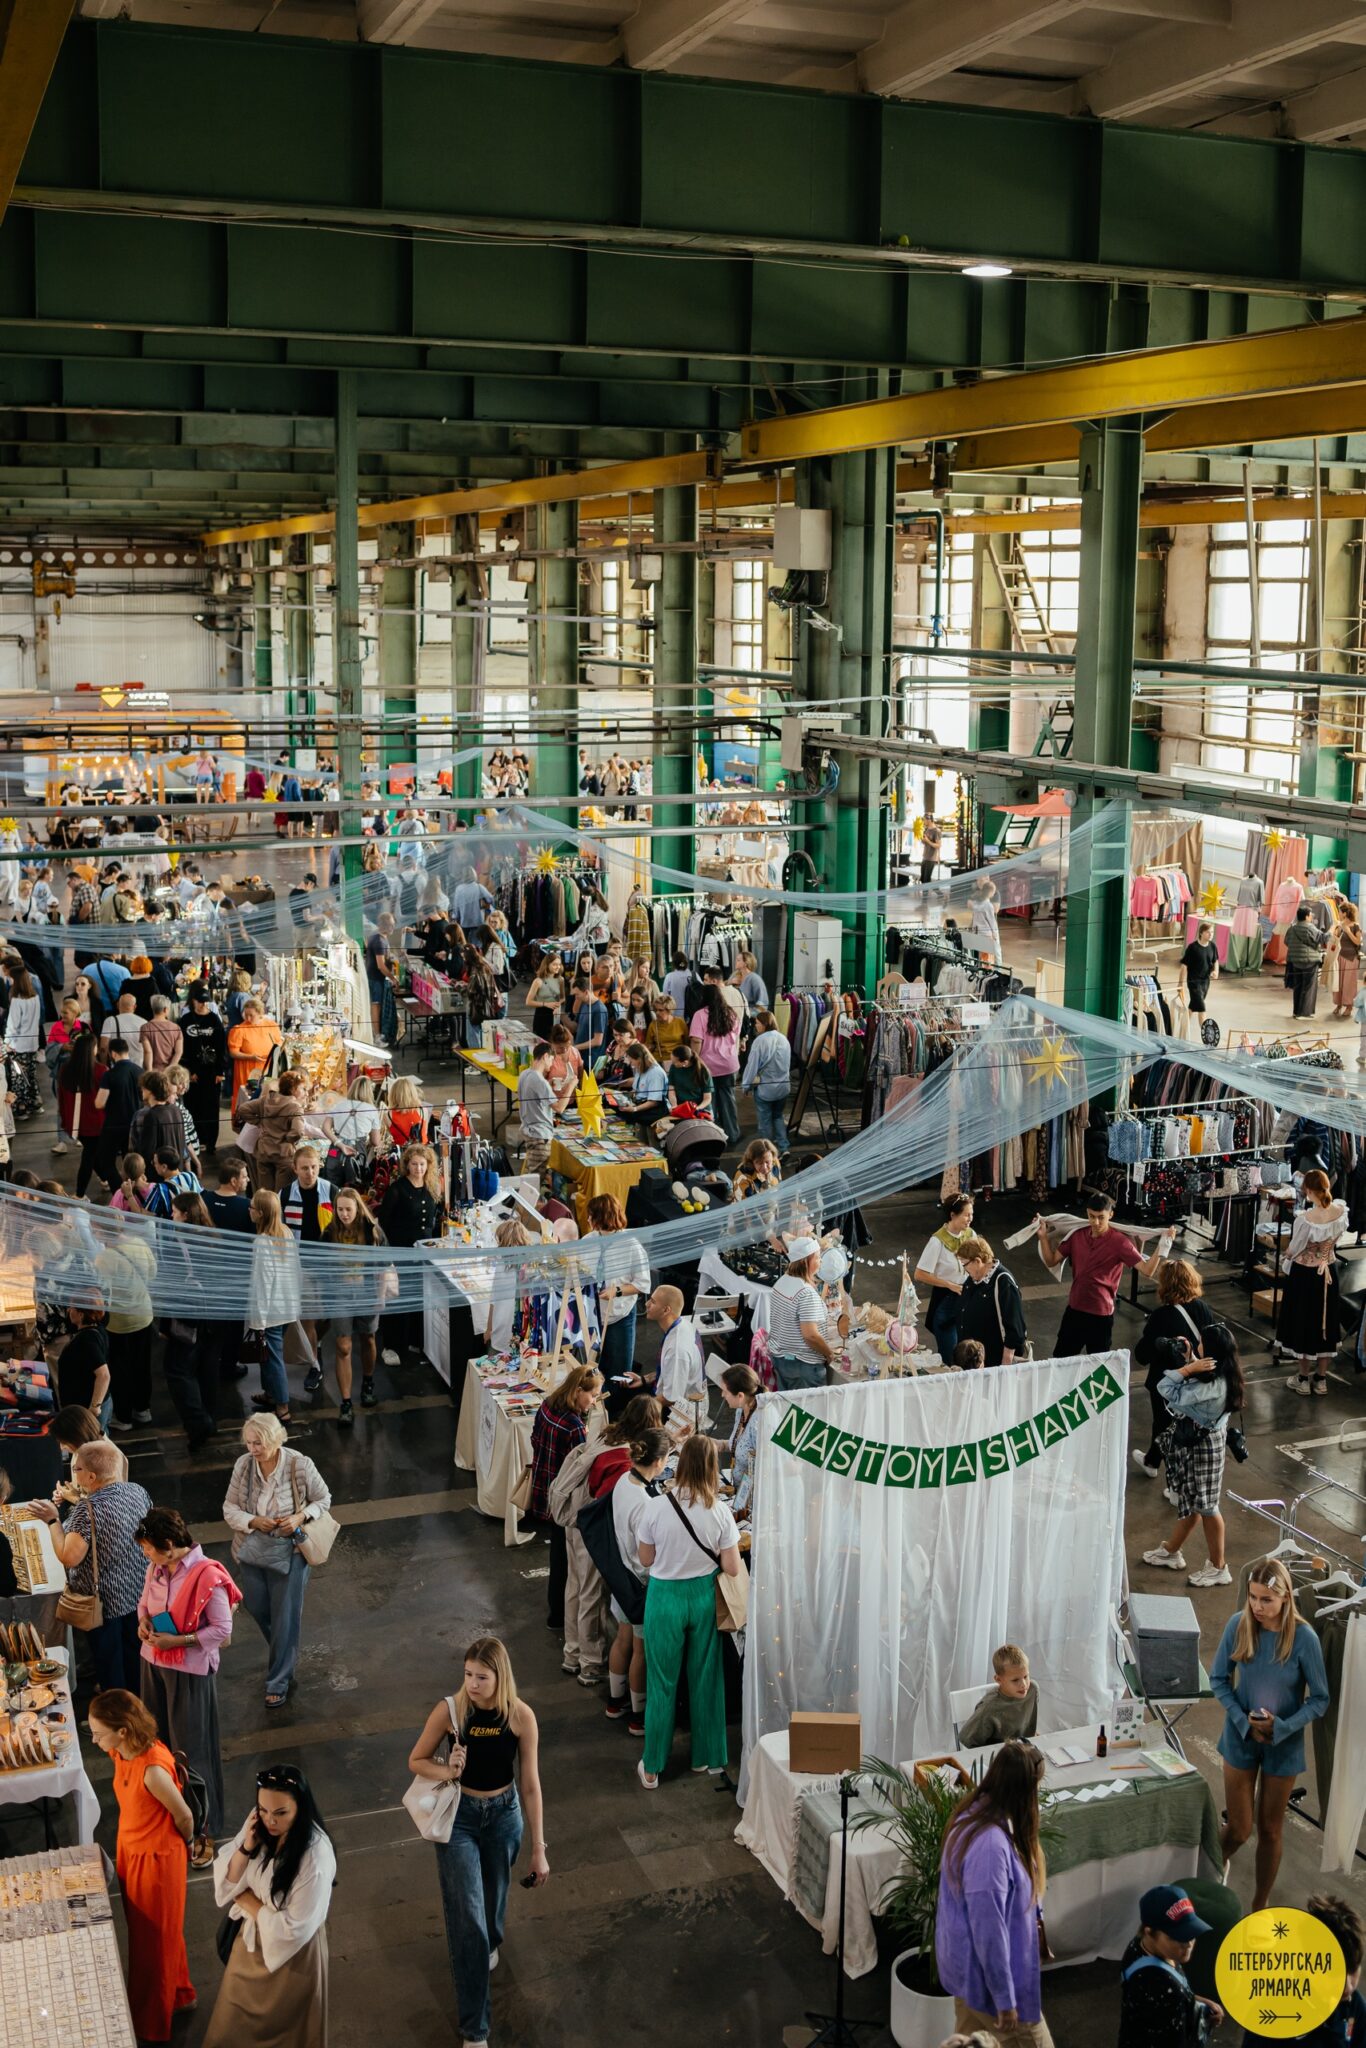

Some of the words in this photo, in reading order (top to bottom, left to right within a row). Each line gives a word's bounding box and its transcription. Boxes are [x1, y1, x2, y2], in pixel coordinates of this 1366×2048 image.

[841, 1021, 854, 1032] SALE
[776, 1373, 1116, 1482] NASTOYASHAYA
[469, 1726, 502, 1737] COSMIC
